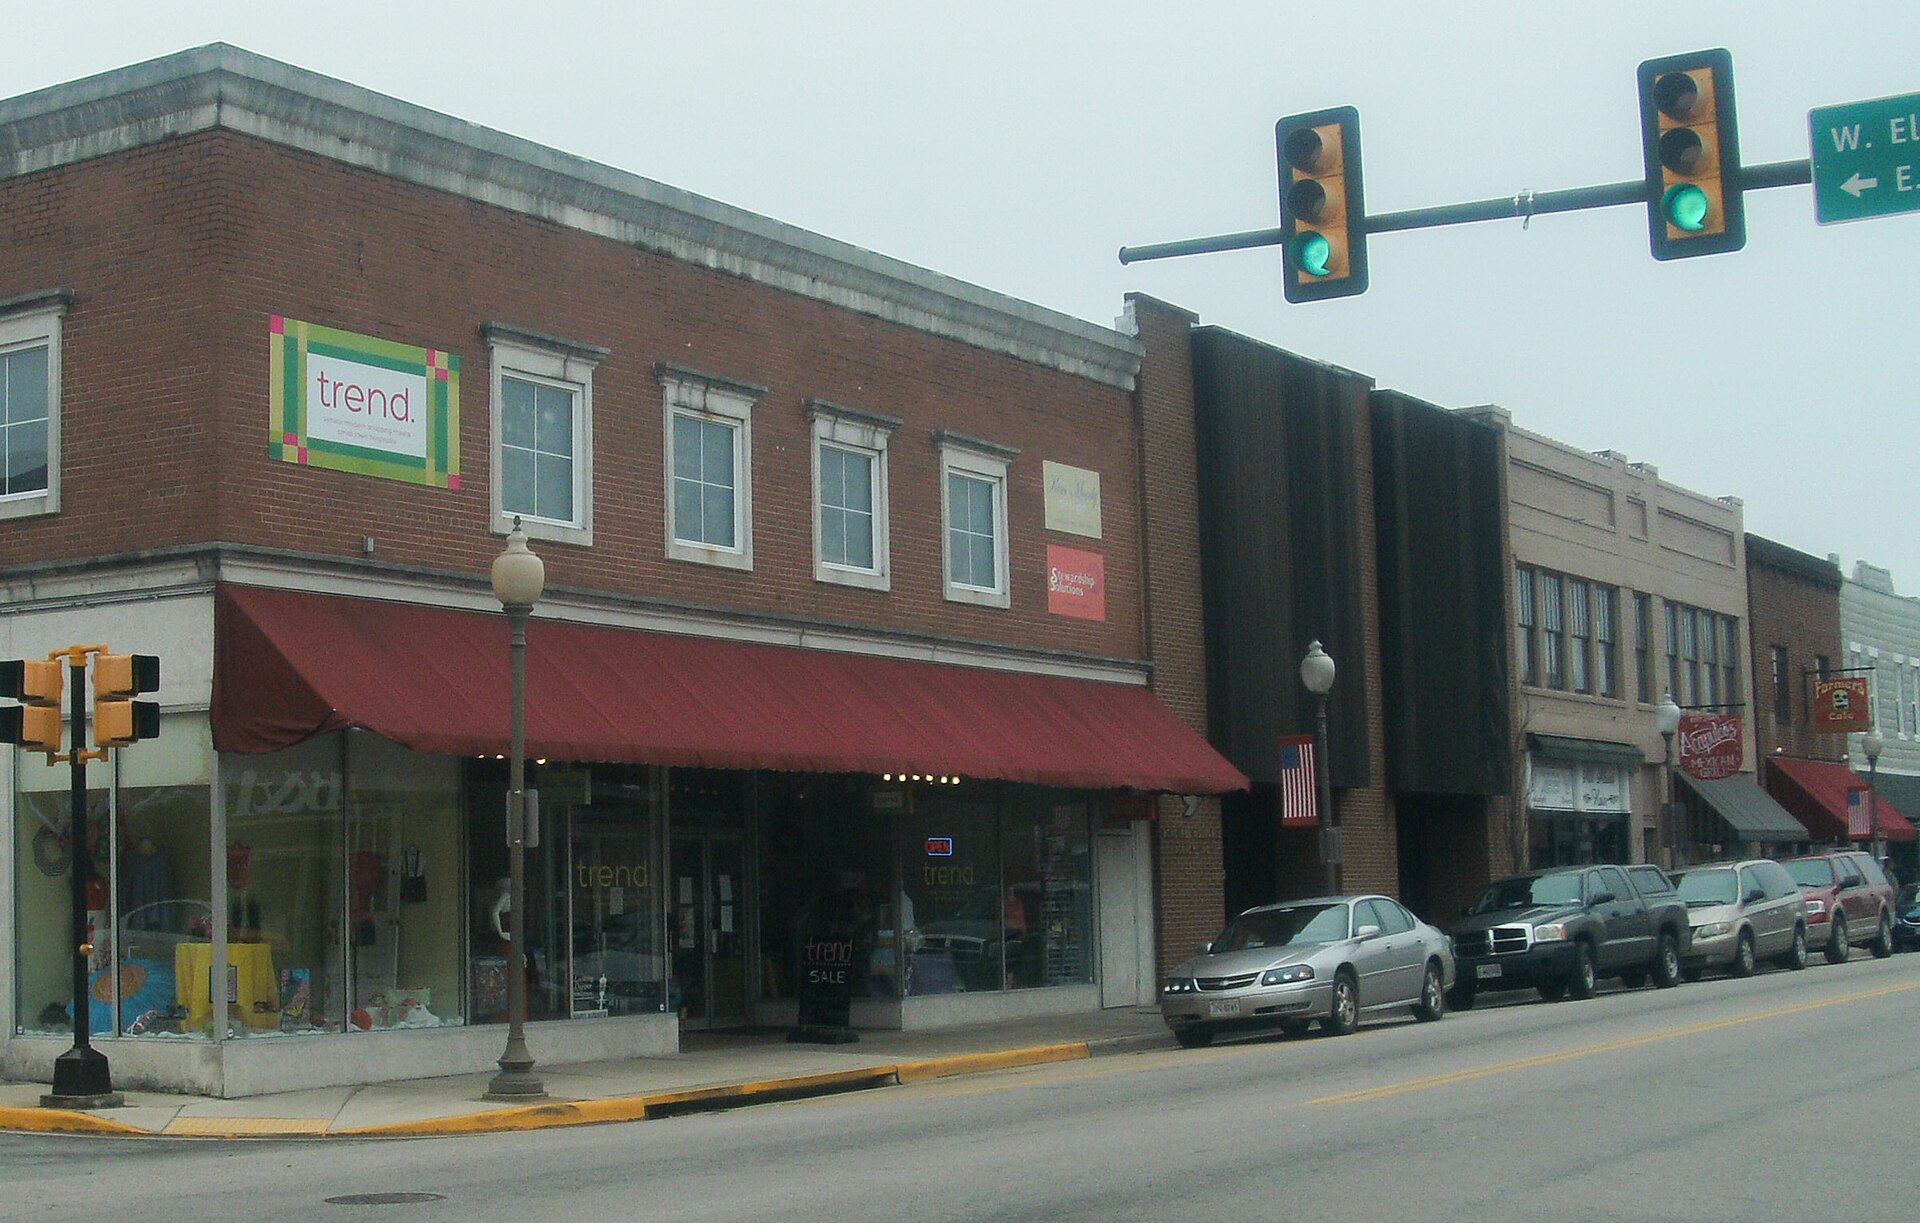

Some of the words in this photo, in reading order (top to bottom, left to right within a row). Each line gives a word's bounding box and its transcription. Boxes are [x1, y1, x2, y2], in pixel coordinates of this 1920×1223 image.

[1831, 124, 1873, 153] W.
[317, 371, 415, 423] trend.
[1050, 567, 1095, 590] Stewardship
[1050, 582, 1084, 597] Solutions
[1815, 681, 1865, 699] Farmers
[1690, 754, 1735, 769] MEXICAN
[804, 936, 853, 963] trend
[809, 970, 846, 984] SALE
